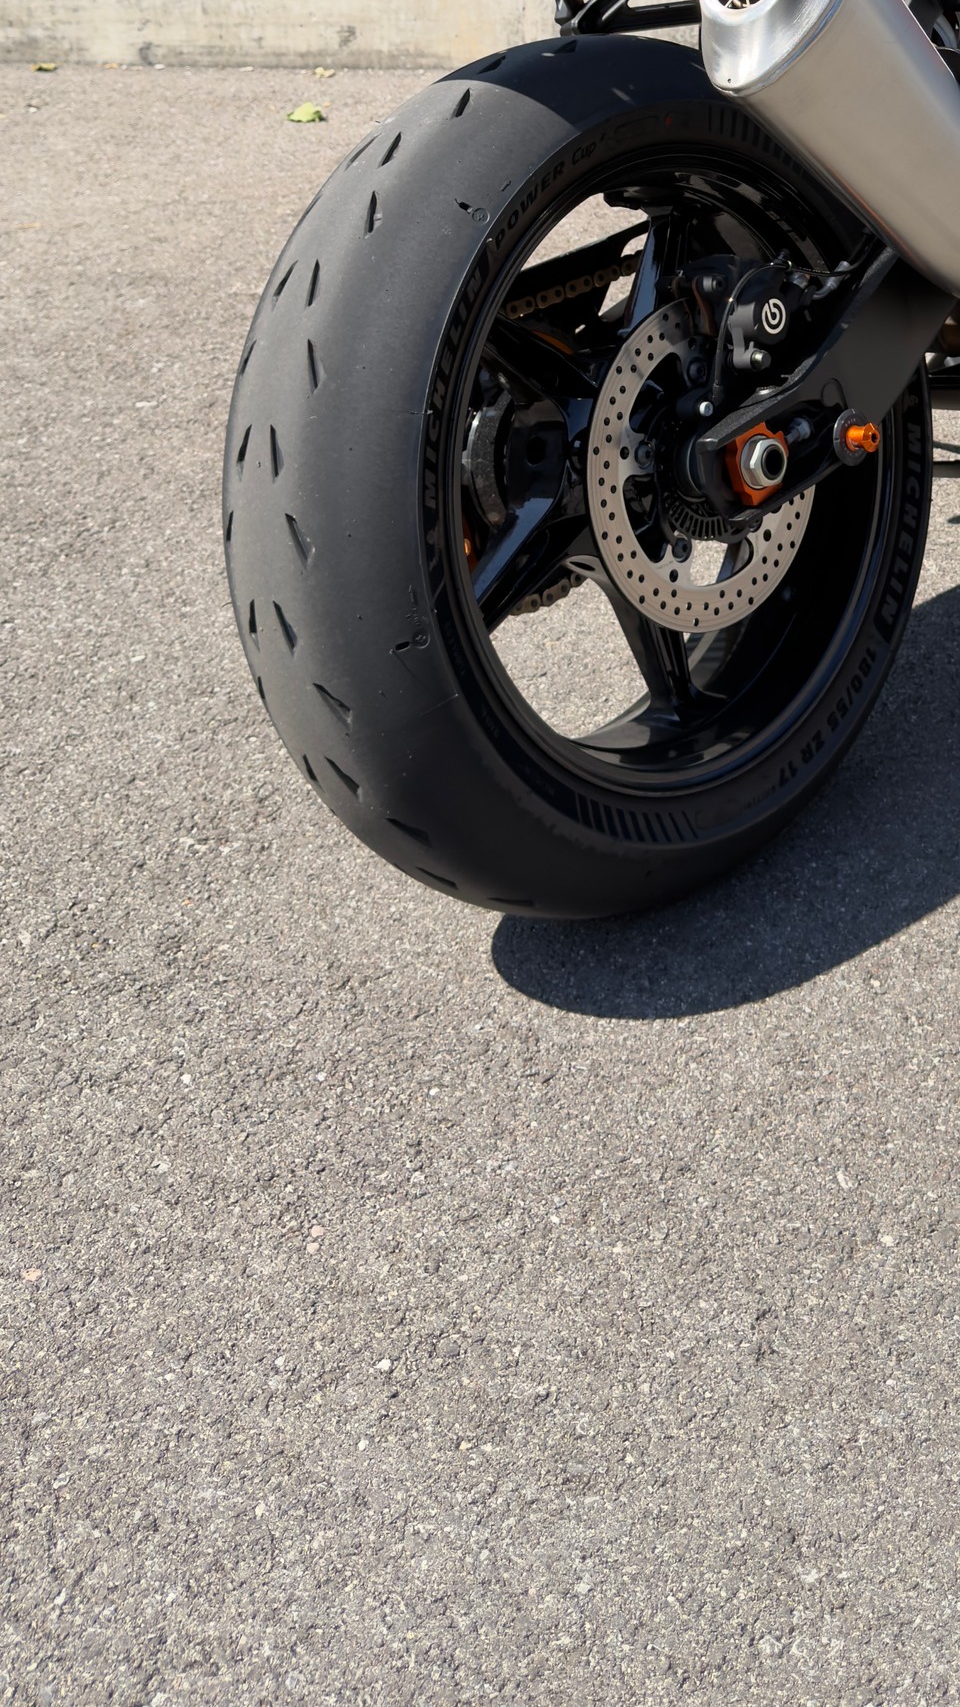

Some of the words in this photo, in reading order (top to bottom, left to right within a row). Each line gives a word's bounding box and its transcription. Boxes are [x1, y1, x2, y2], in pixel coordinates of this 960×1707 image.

[494, 160, 566, 251] POWER
[423, 266, 483, 511] MICHELIN
[880, 421, 922, 627] MICHELIN
[777, 759, 800, 789] 17
[800, 728, 826, 766] ZR
